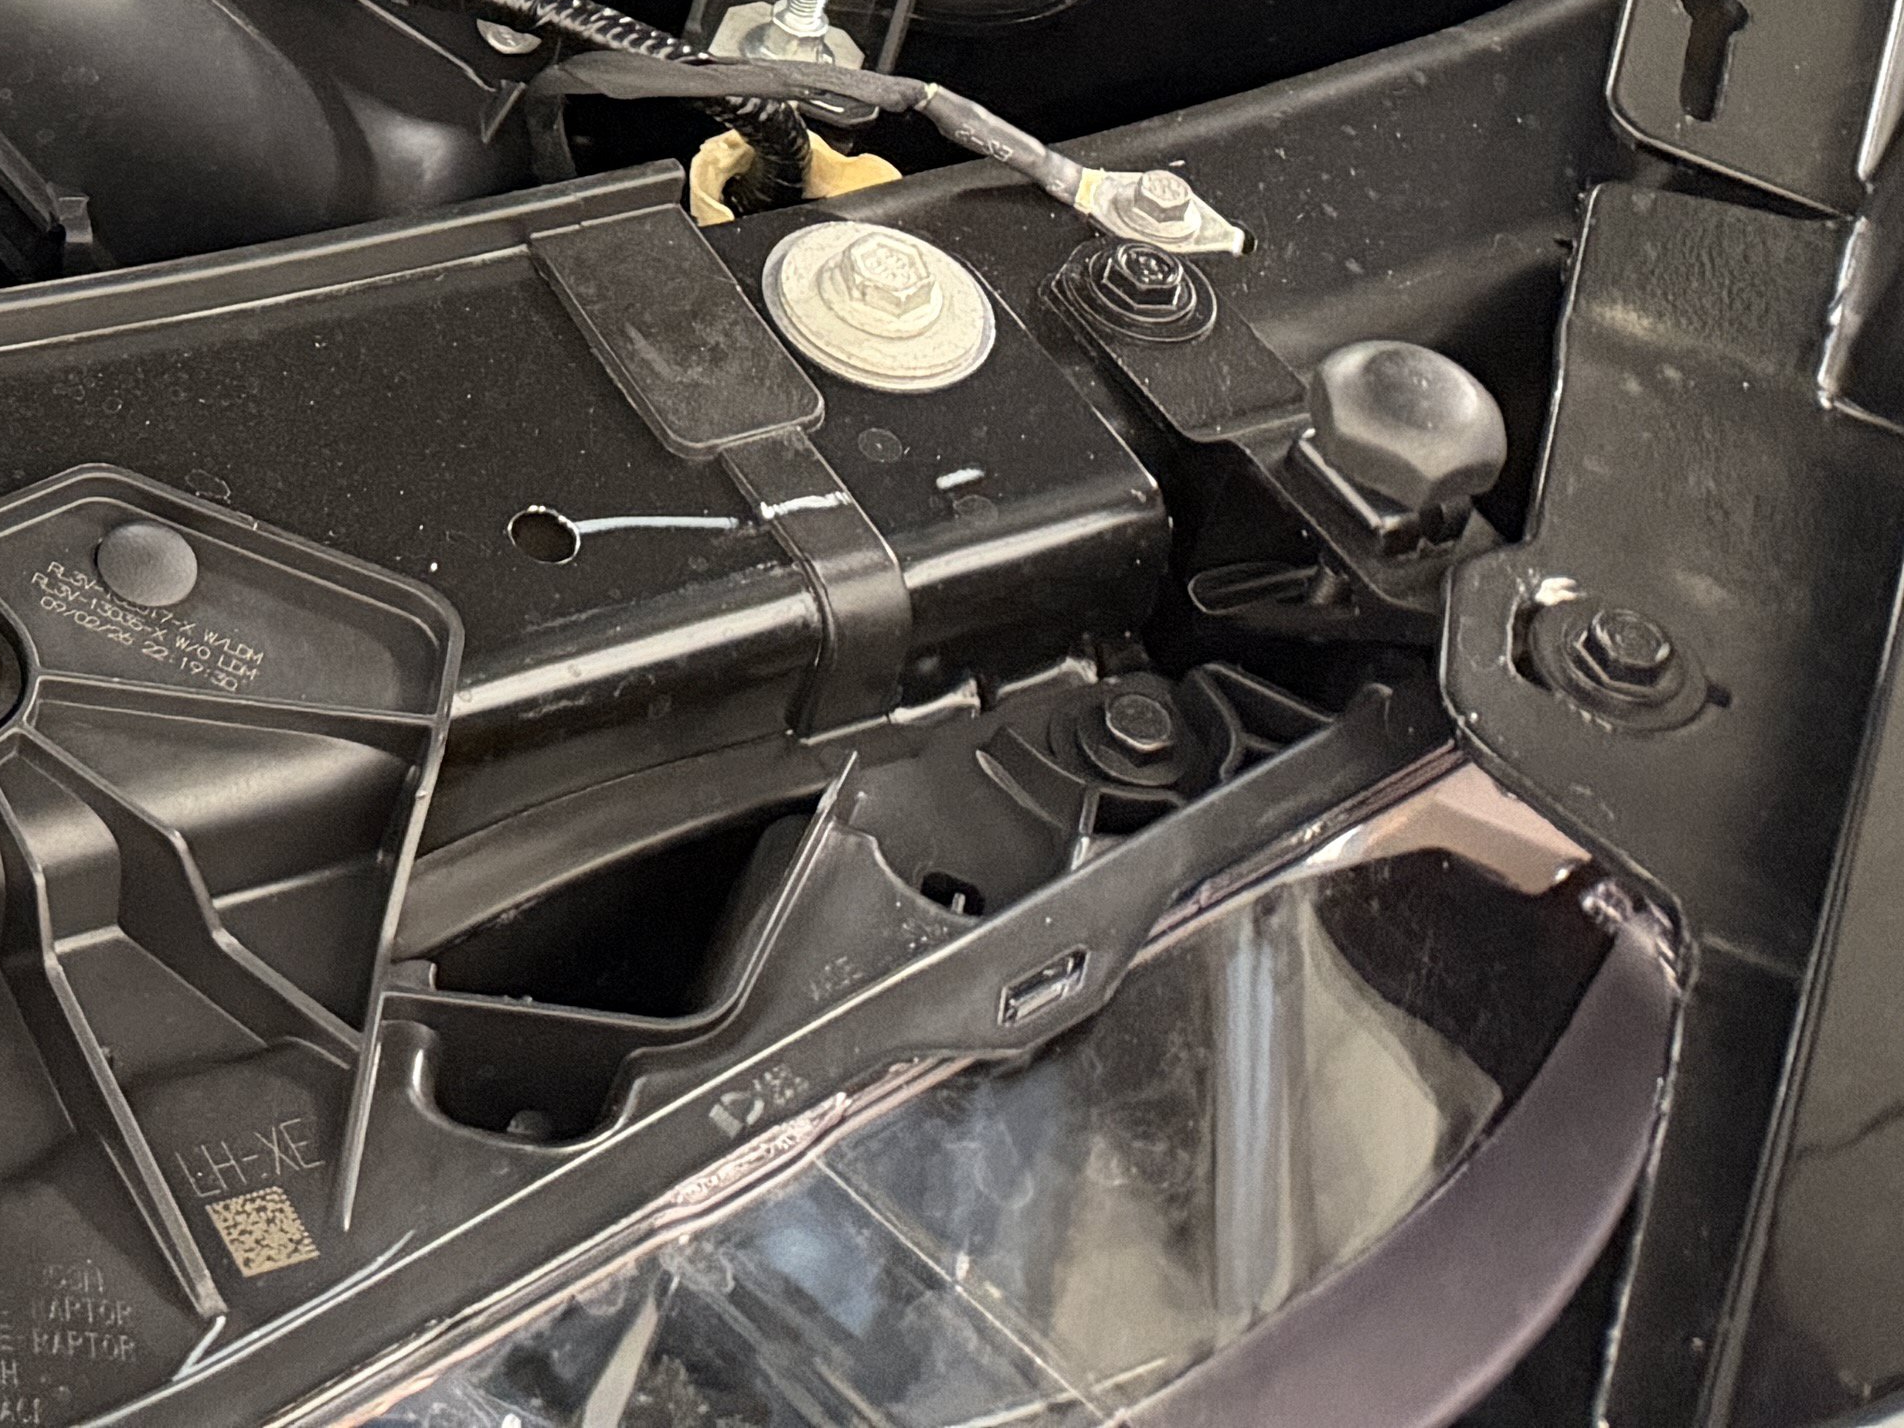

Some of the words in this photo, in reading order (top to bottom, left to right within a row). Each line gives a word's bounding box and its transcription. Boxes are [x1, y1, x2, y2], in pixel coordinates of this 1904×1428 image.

[175, 635, 212, 660] W/O
[217, 656, 259, 681] LDM
[202, 629, 265, 665] W/LDM
[174, 1117, 327, 1198] LH-XE
